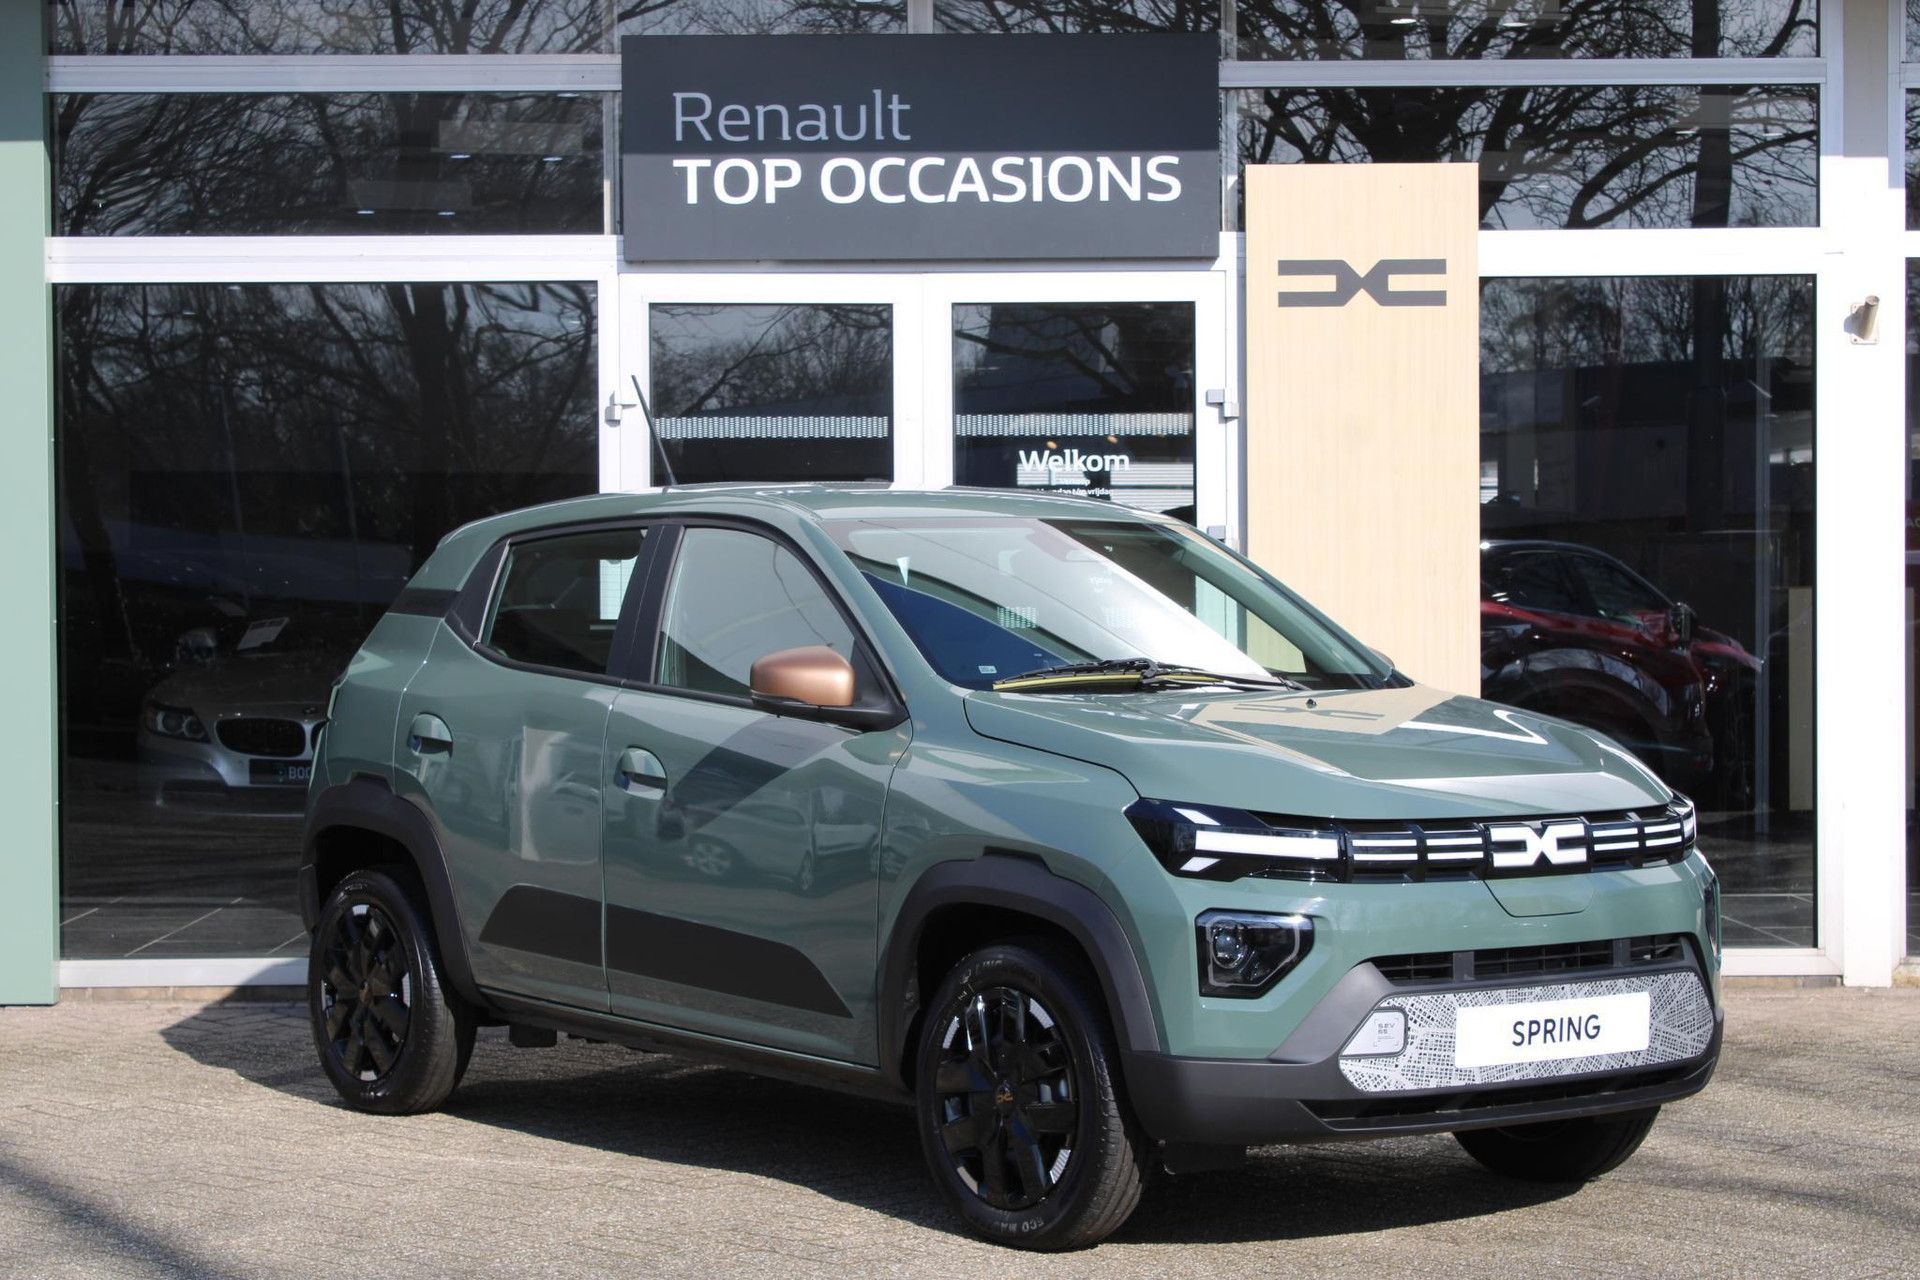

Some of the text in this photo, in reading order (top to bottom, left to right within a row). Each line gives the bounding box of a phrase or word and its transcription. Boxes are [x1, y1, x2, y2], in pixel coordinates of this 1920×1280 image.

[672, 89, 912, 143] Renault
[672, 155, 1182, 206] TOP OCCASIONS
[1018, 449, 1130, 472] Welkom
[1512, 1014, 1601, 1046] SPRING
